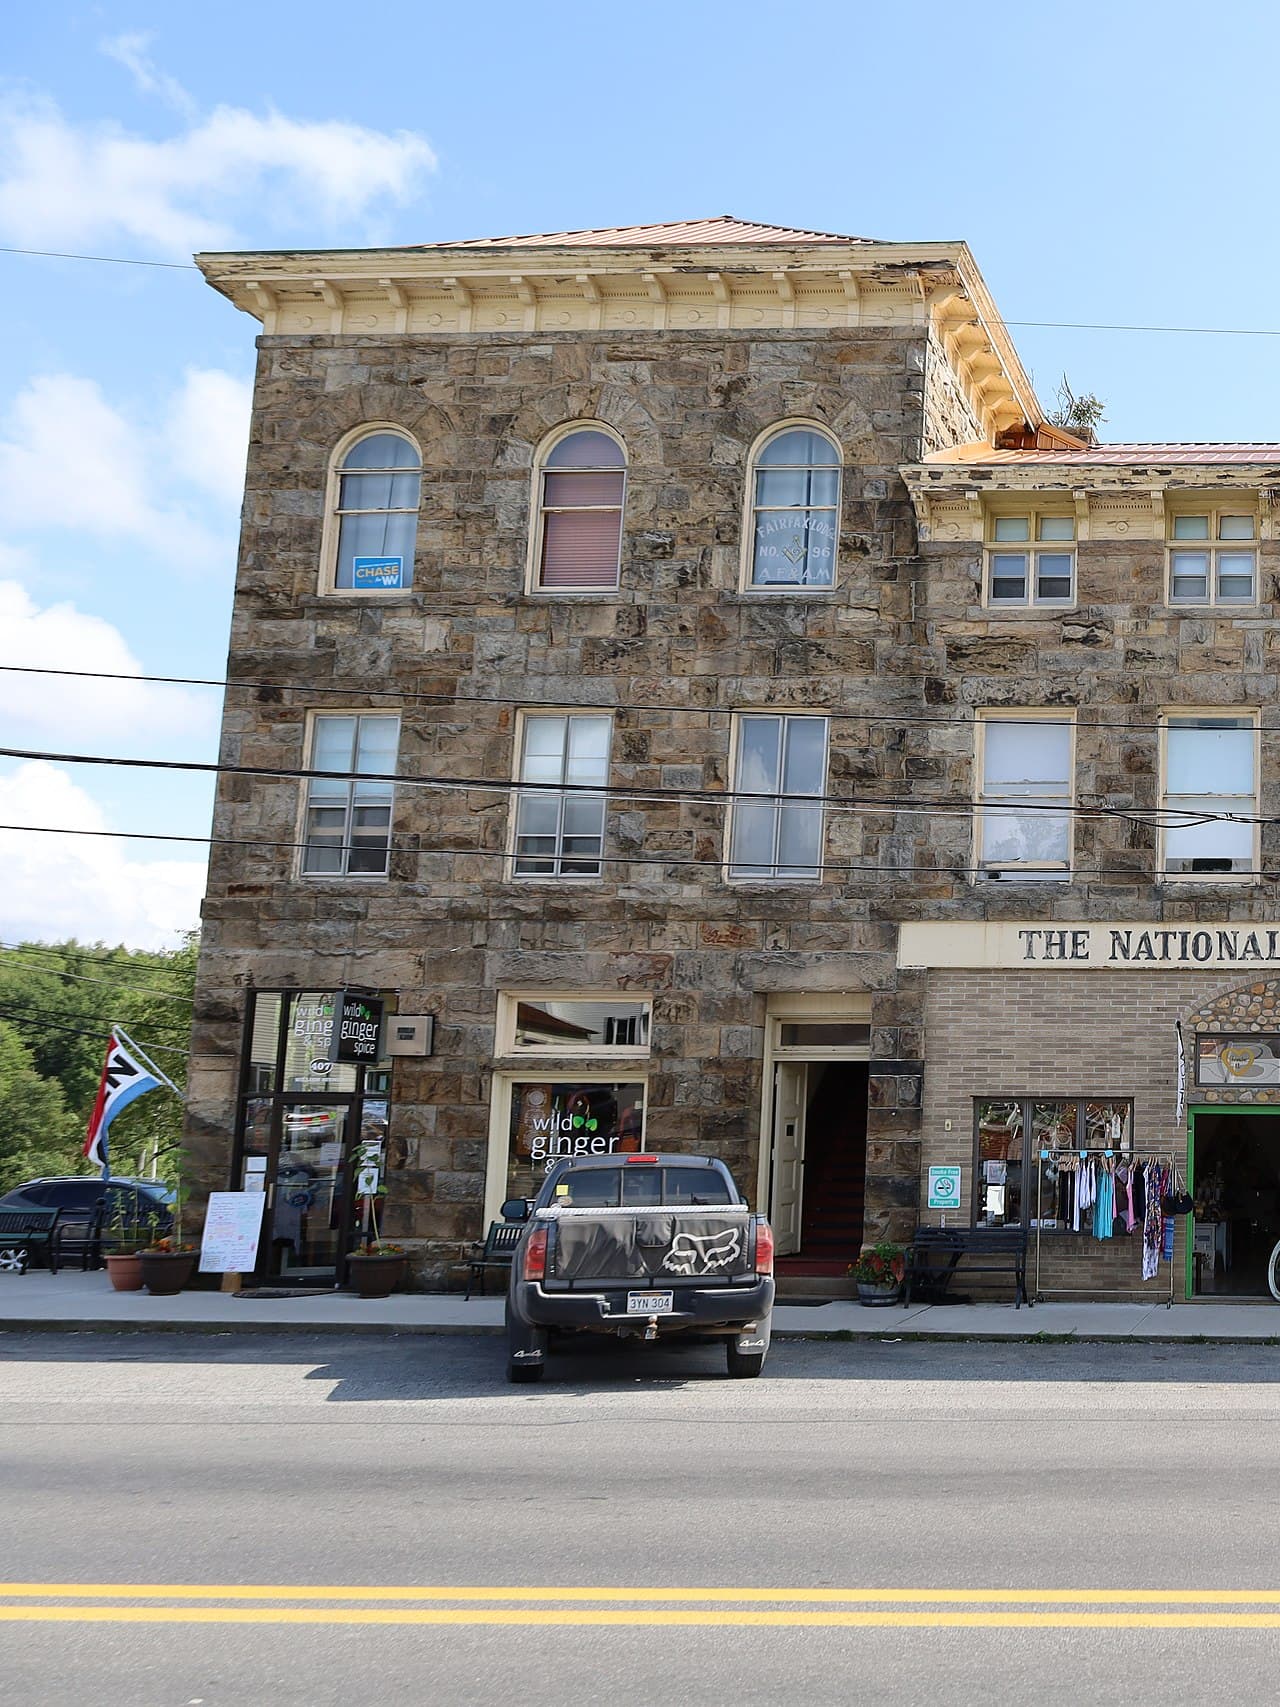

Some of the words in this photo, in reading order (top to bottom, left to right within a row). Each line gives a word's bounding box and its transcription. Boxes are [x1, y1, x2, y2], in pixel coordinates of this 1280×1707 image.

[757, 517, 810, 538] FAIRFAX
[760, 546, 780, 557] NO.
[812, 547, 831, 558] 96
[356, 565, 399, 578] CHASE
[1019, 930, 1090, 960] THE
[343, 1002, 361, 1017] wild
[294, 1019, 334, 1037] ging
[341, 1018, 379, 1041] ginger
[353, 1040, 376, 1056] spice
[311, 1062, 331, 1072] 407
[533, 1113, 573, 1131] wild
[531, 1131, 620, 1160] ginger
[630, 1298, 648, 1309] 3YN
[652, 1298, 669, 1308] 304
